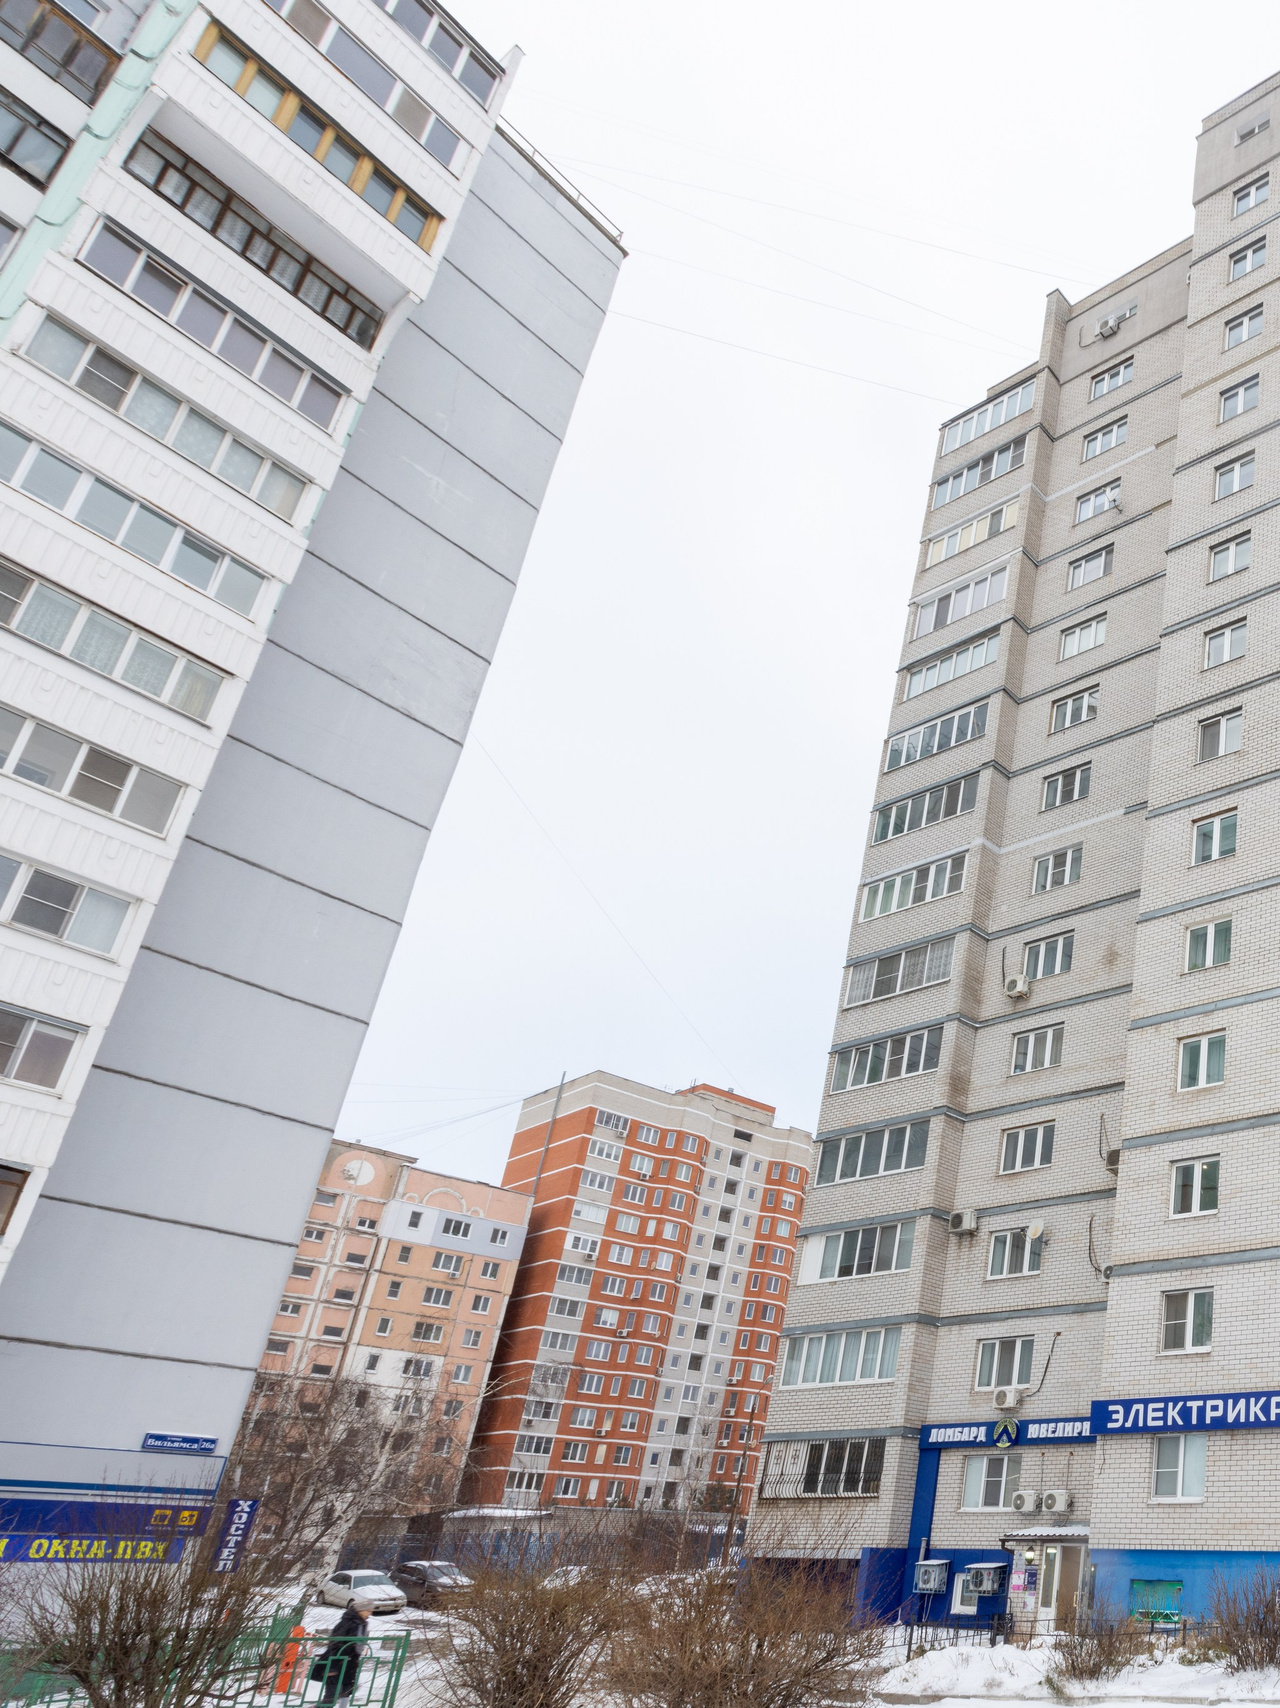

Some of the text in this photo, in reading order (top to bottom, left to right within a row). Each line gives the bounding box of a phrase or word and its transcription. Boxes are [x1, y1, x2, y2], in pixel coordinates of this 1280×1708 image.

[928, 1426, 987, 1443] ЛОМБАРД
[147, 1439, 198, 1449] Вильямса
[214, 1500, 254, 1572] ХОСТЕЛ
